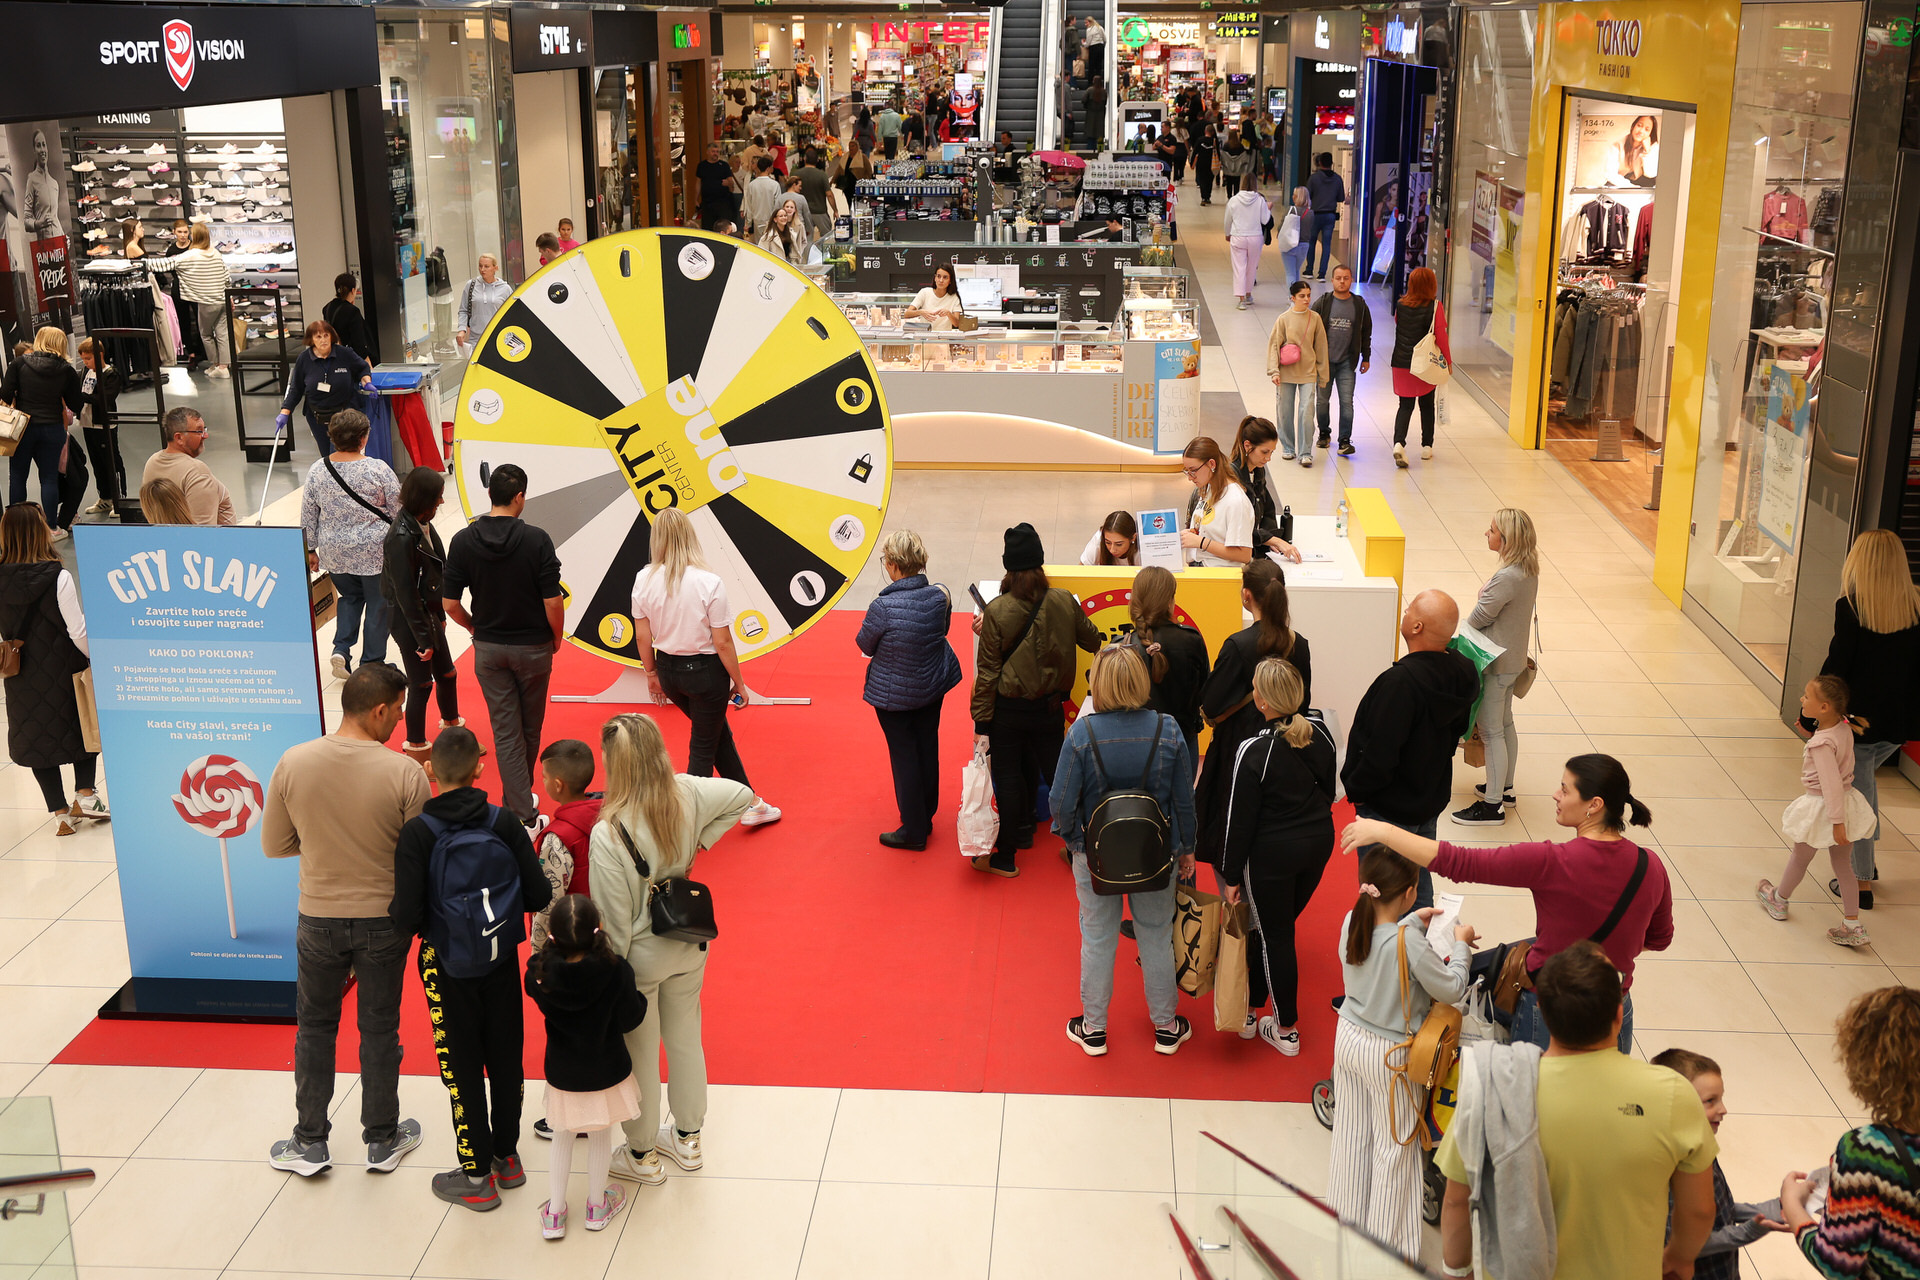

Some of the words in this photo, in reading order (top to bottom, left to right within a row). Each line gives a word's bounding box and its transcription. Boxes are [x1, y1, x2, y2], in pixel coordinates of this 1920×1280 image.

[100, 41, 160, 65] SPORT
[196, 39, 245, 61] VISION
[1599, 63, 1631, 78] FASHION
[39, 266, 68, 291] PRIDE
[666, 375, 745, 493] one
[604, 423, 678, 516] CITY
[657, 441, 696, 501] CENTER
[146, 607, 189, 617] Zavrtite
[192, 608, 215, 617] kolo
[218, 607, 247, 617] sreće
[138, 618, 180, 628] osvojite
[183, 620, 214, 629] super
[217, 620, 264, 629] nagrade!
[149, 649, 178, 658] KAKO
[181, 649, 196, 658] DO
[199, 649, 254, 659] POKLONA?
[124, 666, 157, 675] Pojavite
[171, 666, 186, 674] kod
[189, 666, 207, 674] kola
[209, 667, 231, 675] sreće
[240, 667, 277, 676] računom
[134, 676, 177, 685] shoppinga
[187, 676, 213, 684] iznosu
[215, 676, 242, 684] većem
[244, 677, 255, 685] od
[126, 684, 159, 693] Zavrtite
[258, 687, 286, 695] rukom
[127, 694, 169, 702] Preuzmite
[171, 695, 200, 704] poklon
[207, 695, 240, 705] uživajte
[249, 696, 281, 704] ostatku
[282, 697, 302, 705] dana
[147, 720, 173, 729] Kada
[176, 720, 196, 731] City
[199, 721, 228, 731] slavi,
[231, 721, 260, 731] sreća
[262, 722, 272, 732] je
[170, 731, 183, 740] na
[185, 730, 214, 742] vašoj
[216, 731, 251, 741] strani!
